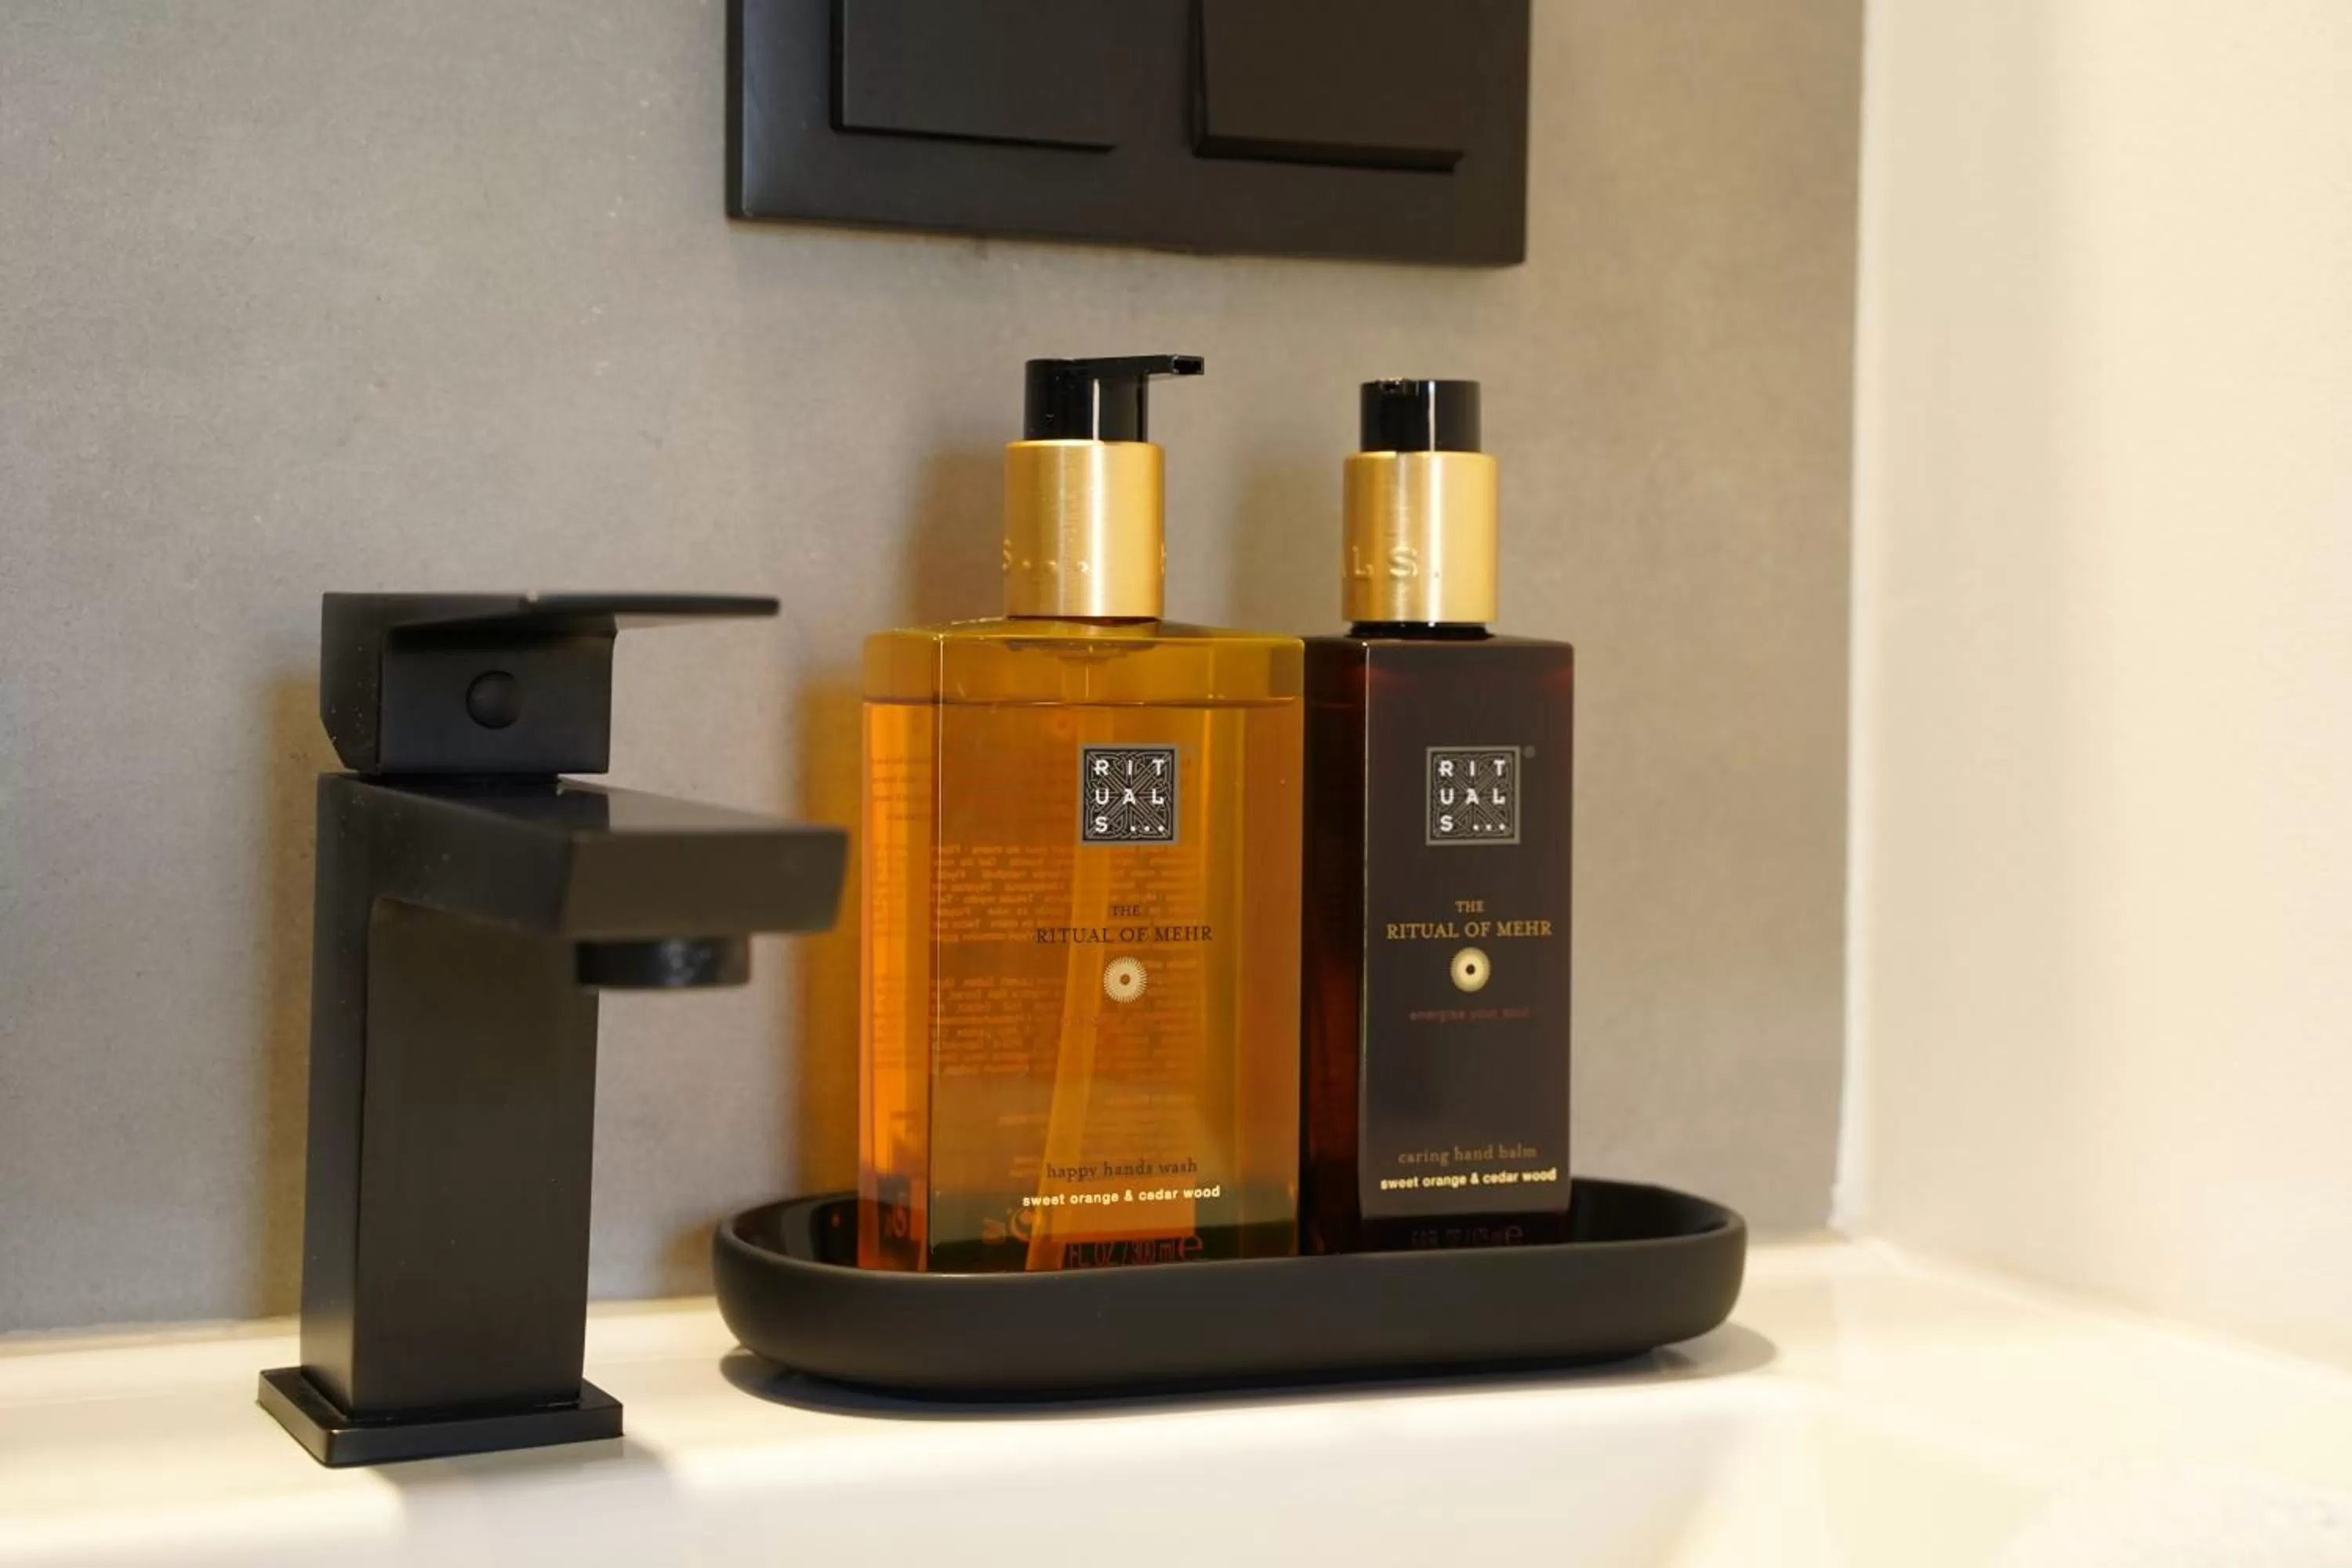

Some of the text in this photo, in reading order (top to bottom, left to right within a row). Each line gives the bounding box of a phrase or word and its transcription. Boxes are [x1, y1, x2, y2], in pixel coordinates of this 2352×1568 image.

[1112, 905, 1141, 916] THE
[1454, 900, 1485, 913] THE
[1036, 925, 1214, 943] RITUAL OF MEHR
[1386, 920, 1553, 940] RITUAL OF MEHR
[1398, 1142, 1537, 1167] caring hand balm
[1047, 1156, 1199, 1182] happy hands wash
[1380, 1167, 1557, 1190] sweet orange & cedar wood
[1022, 1185, 1221, 1207] sweet orange & cedar wood
